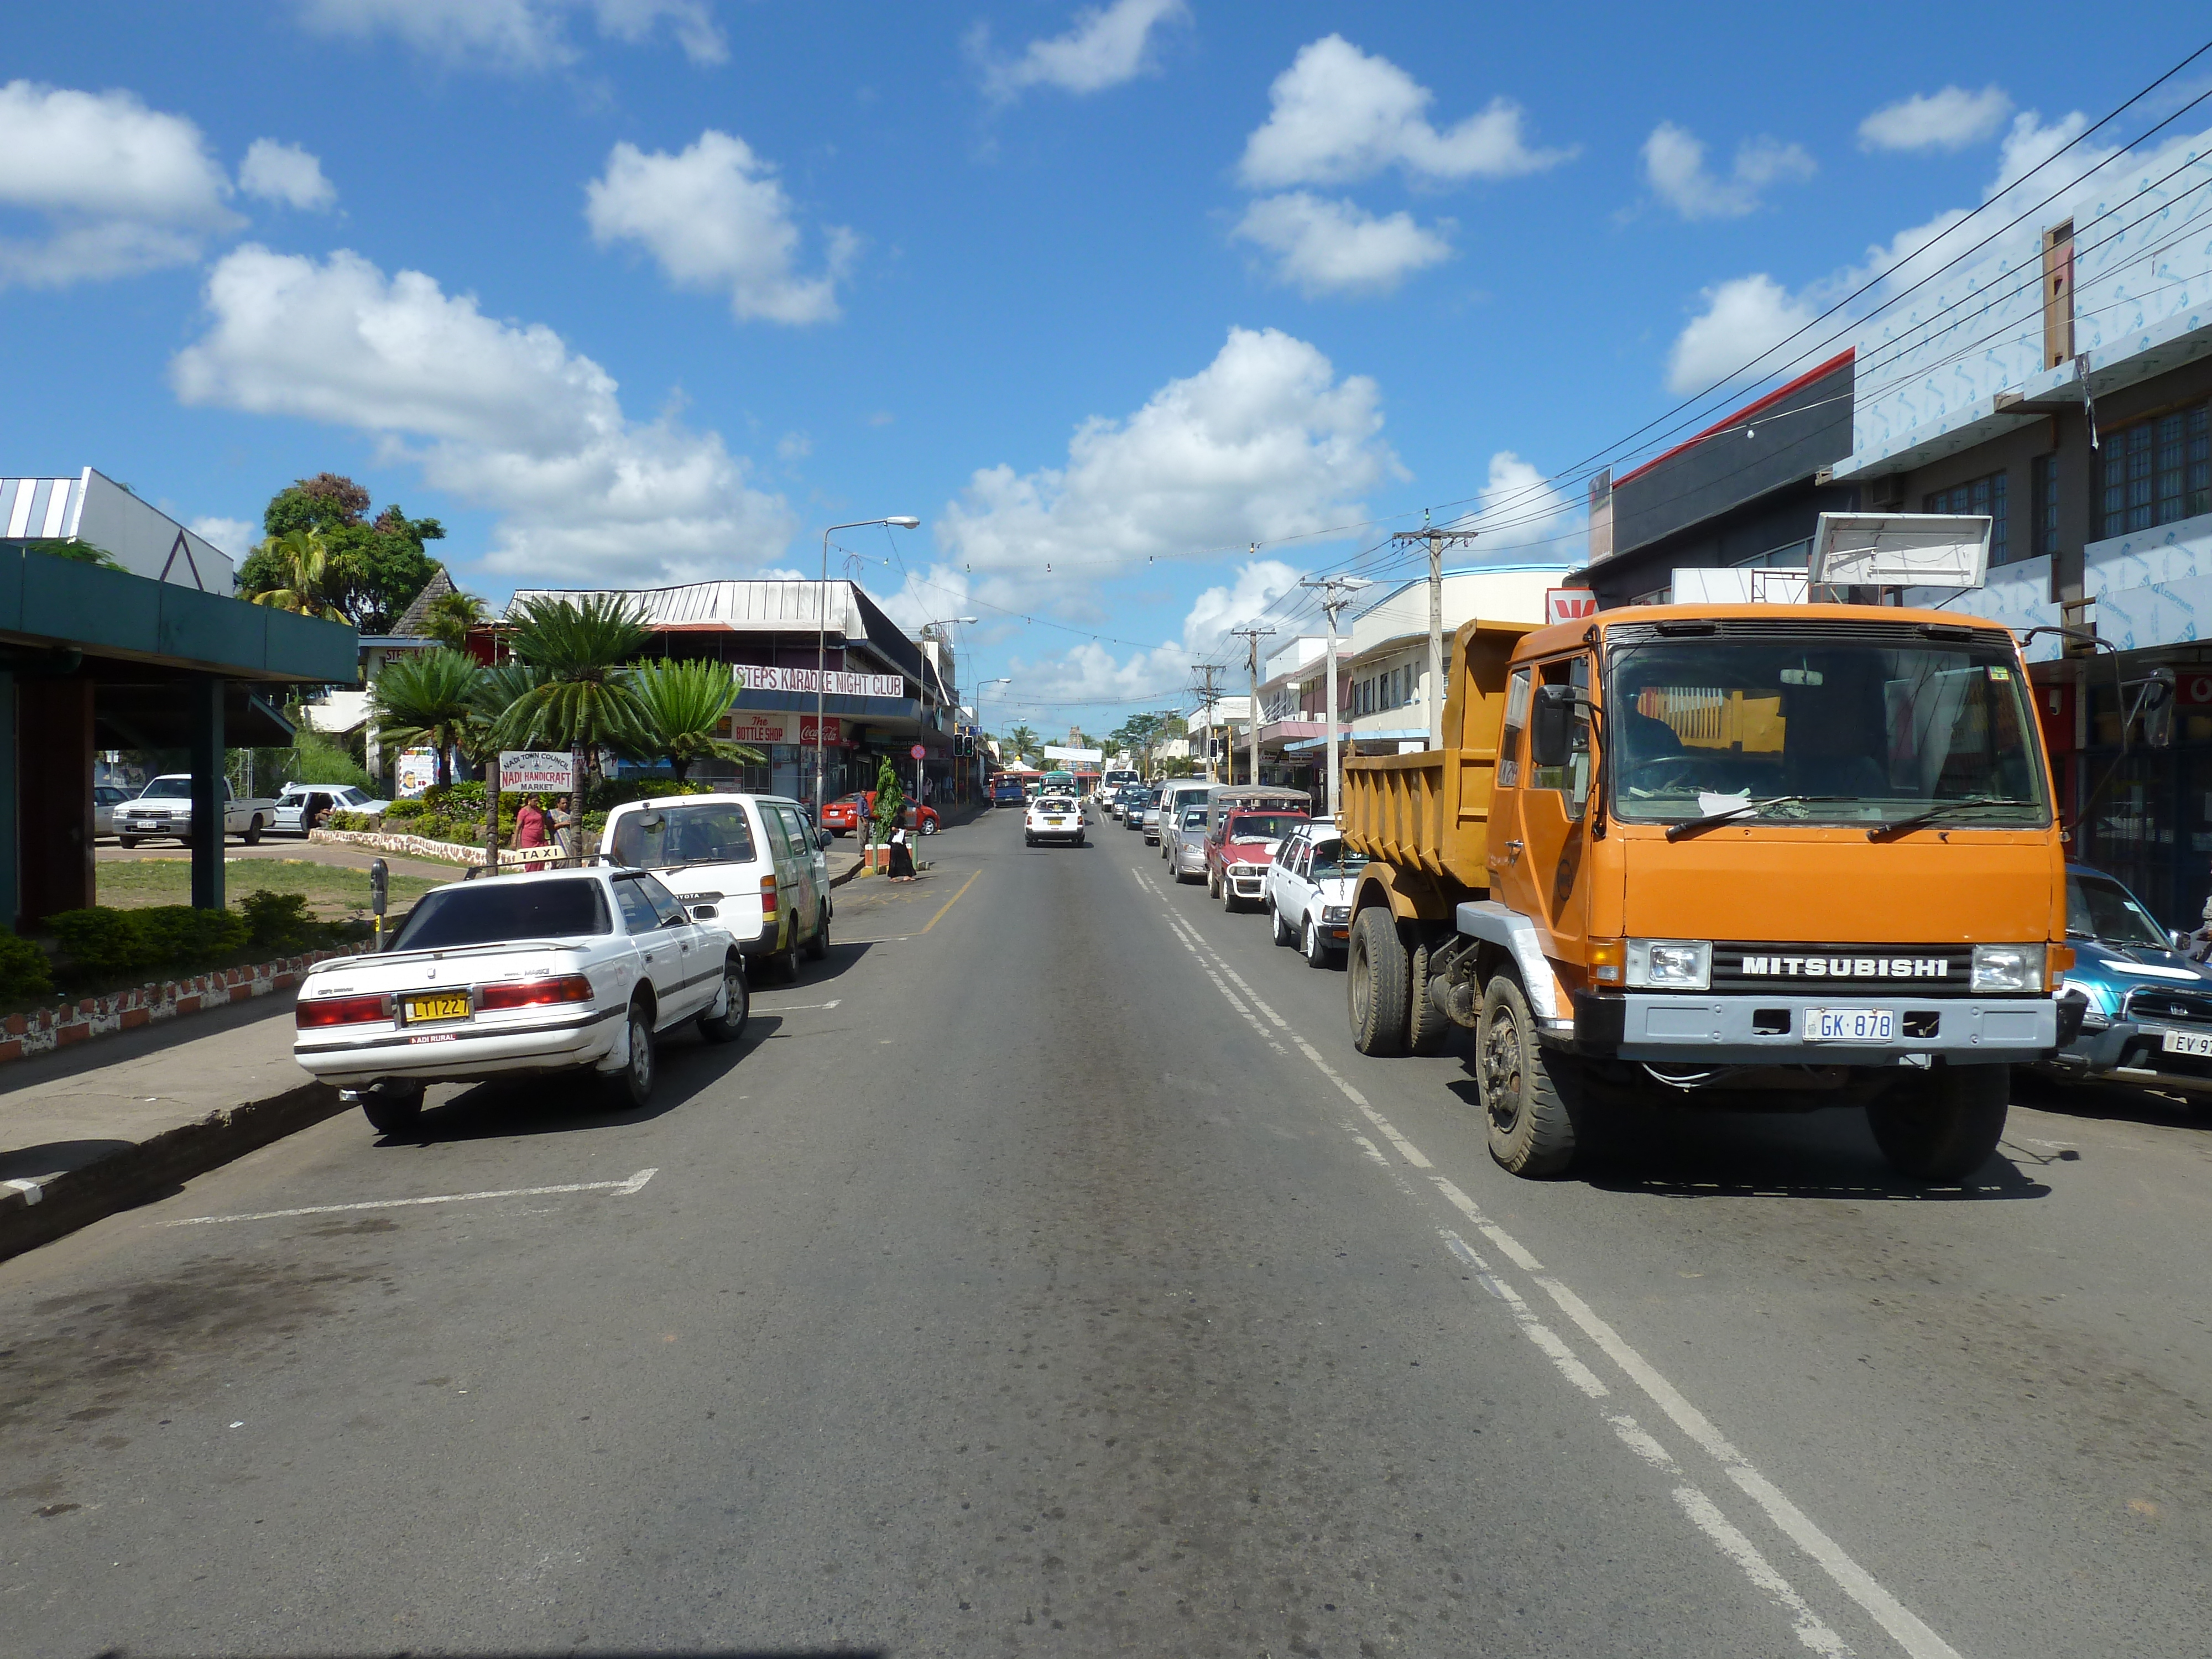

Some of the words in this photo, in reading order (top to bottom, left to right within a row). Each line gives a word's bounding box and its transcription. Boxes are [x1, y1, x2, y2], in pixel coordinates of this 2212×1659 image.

[736, 666, 777, 688] STEPS
[836, 672, 869, 694] NIGHT
[873, 676, 901, 696] CLUB
[752, 716, 768, 726] The
[736, 726, 763, 740] BOTTLE
[765, 727, 782, 741] SHOP
[503, 757, 520, 770] NADI
[541, 753, 568, 770] COUNCIL
[502, 771, 521, 788] NADI
[524, 771, 571, 787] HANDICRAFT
[520, 848, 557, 859] TAXI
[1743, 957, 1948, 977] MITSUBISHI
[430, 1034, 456, 1042] RURAL
